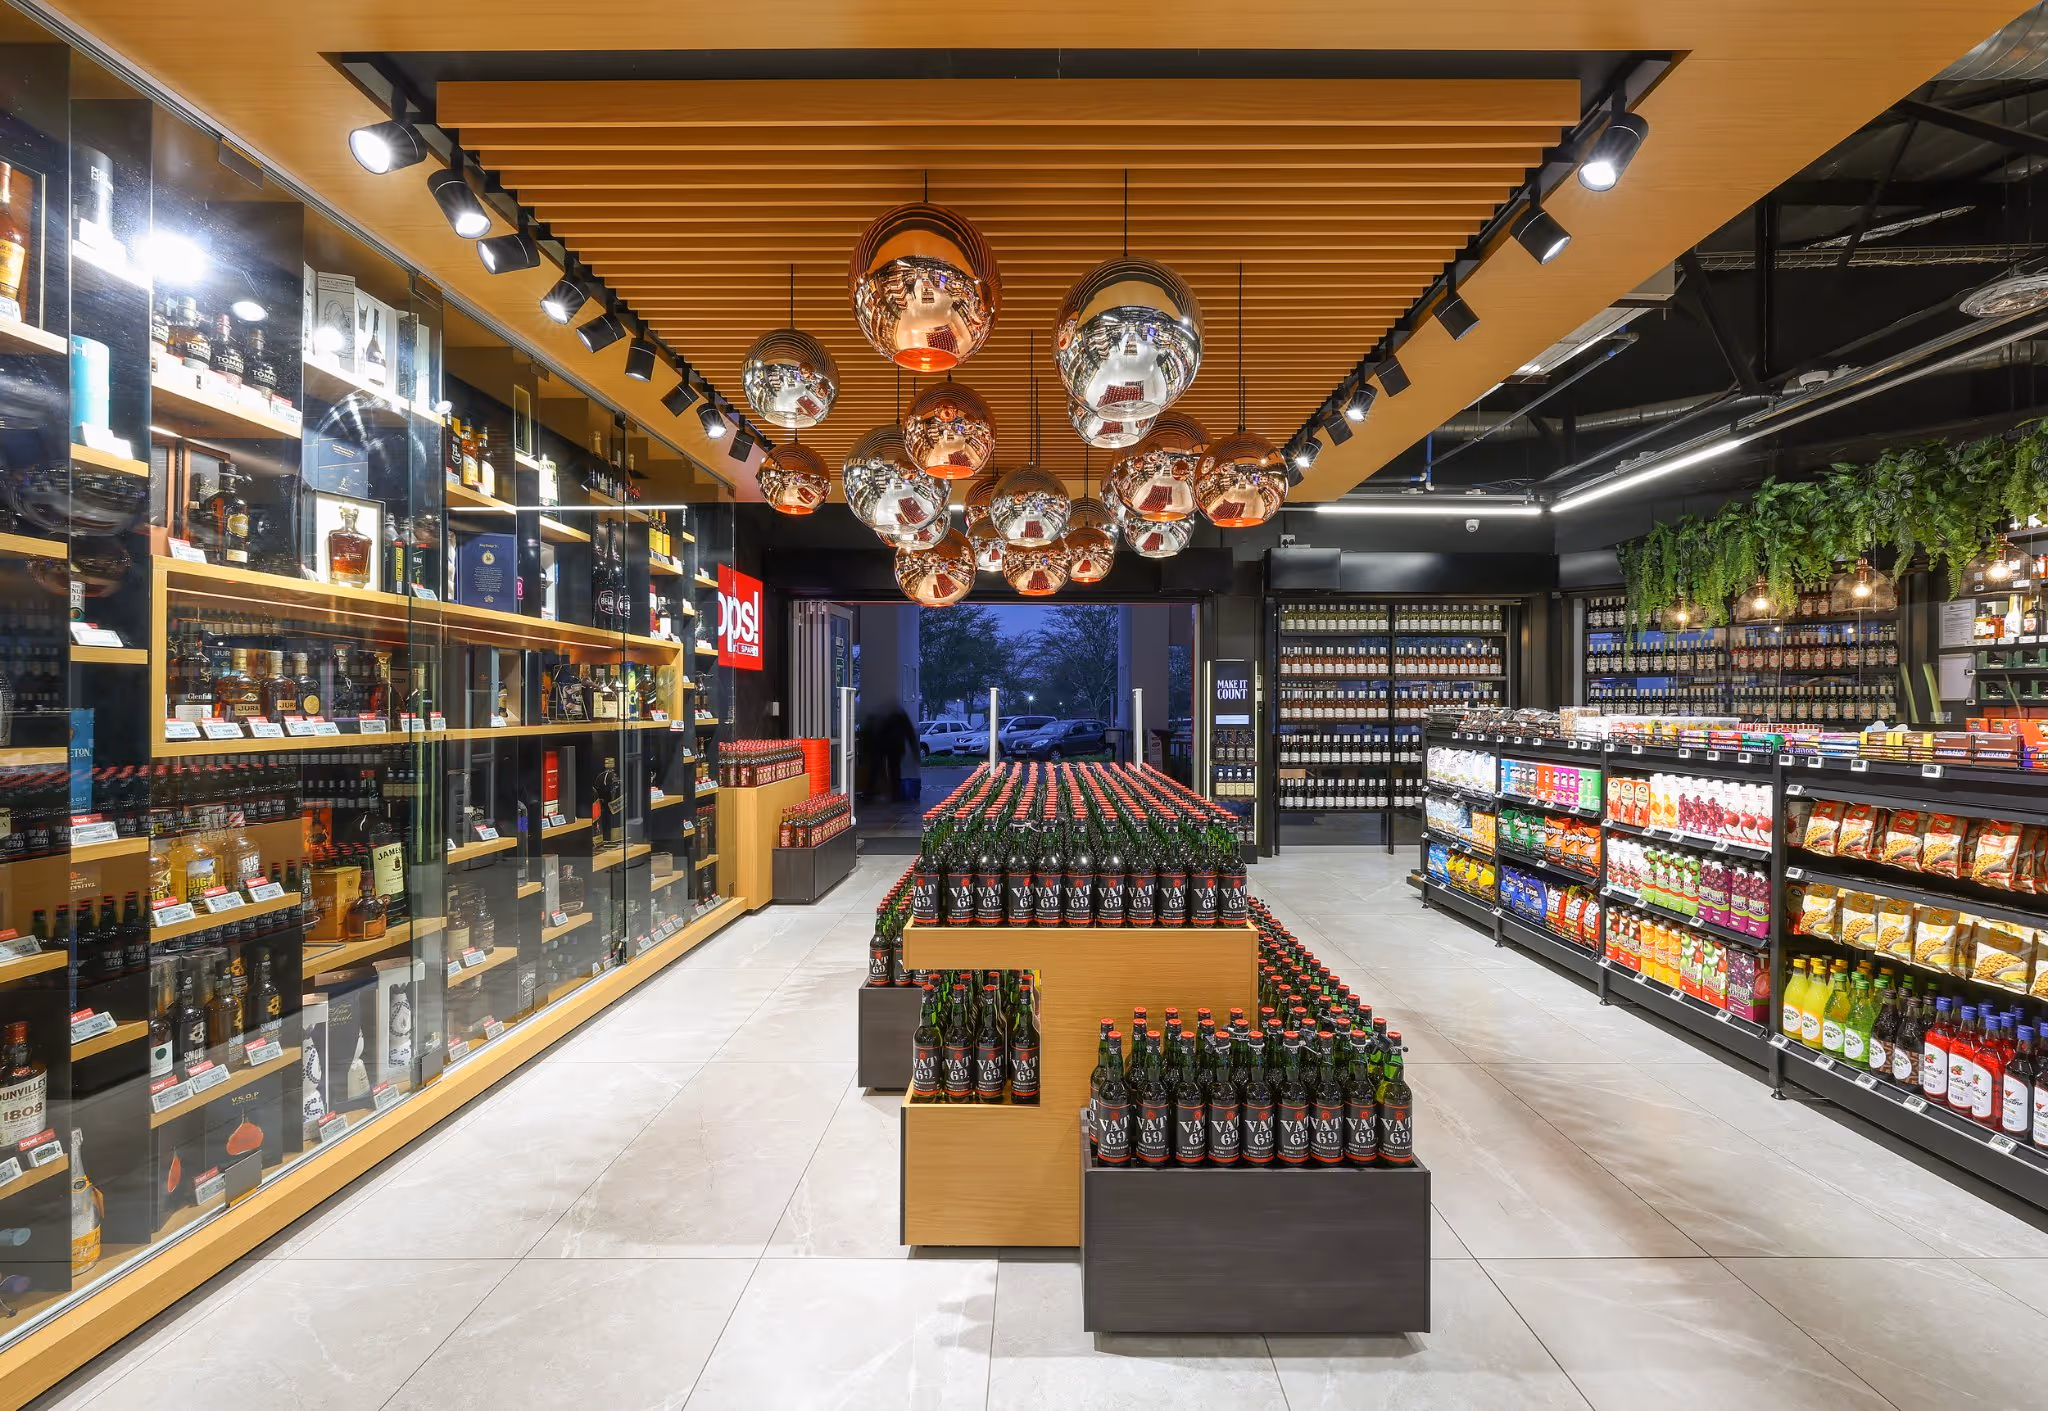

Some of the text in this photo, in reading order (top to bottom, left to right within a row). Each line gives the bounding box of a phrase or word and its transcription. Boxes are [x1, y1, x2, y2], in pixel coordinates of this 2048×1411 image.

[718, 591, 759, 653] ops!
[1217, 679, 1248, 689] MAKE IT
[1217, 688, 1248, 700] COUNT
[242, 855, 259, 869] BIG
[912, 884, 936, 896] VAT
[976, 883, 1004, 898] VAT
[1034, 884, 1061, 898] VAT
[1064, 884, 1092, 898] VAT
[1098, 884, 1124, 898] VAT
[1128, 884, 1155, 898] VAT
[1220, 884, 1247, 899] VAT
[912, 1056, 938, 1070] VAT
[944, 1056, 972, 1070] VAT
[976, 1055, 1004, 1070] VAT
[1012, 1056, 1038, 1070] VAT
[3, 1102, 43, 1122] 1808
[1098, 1114, 1130, 1132] VAT
[1136, 1115, 1168, 1132] VAT
[1244, 1114, 1274, 1133] VAT
[1309, 1116, 1342, 1132] VAT
[1346, 1114, 1378, 1132] VAT
[1380, 1114, 1412, 1132] VAT
